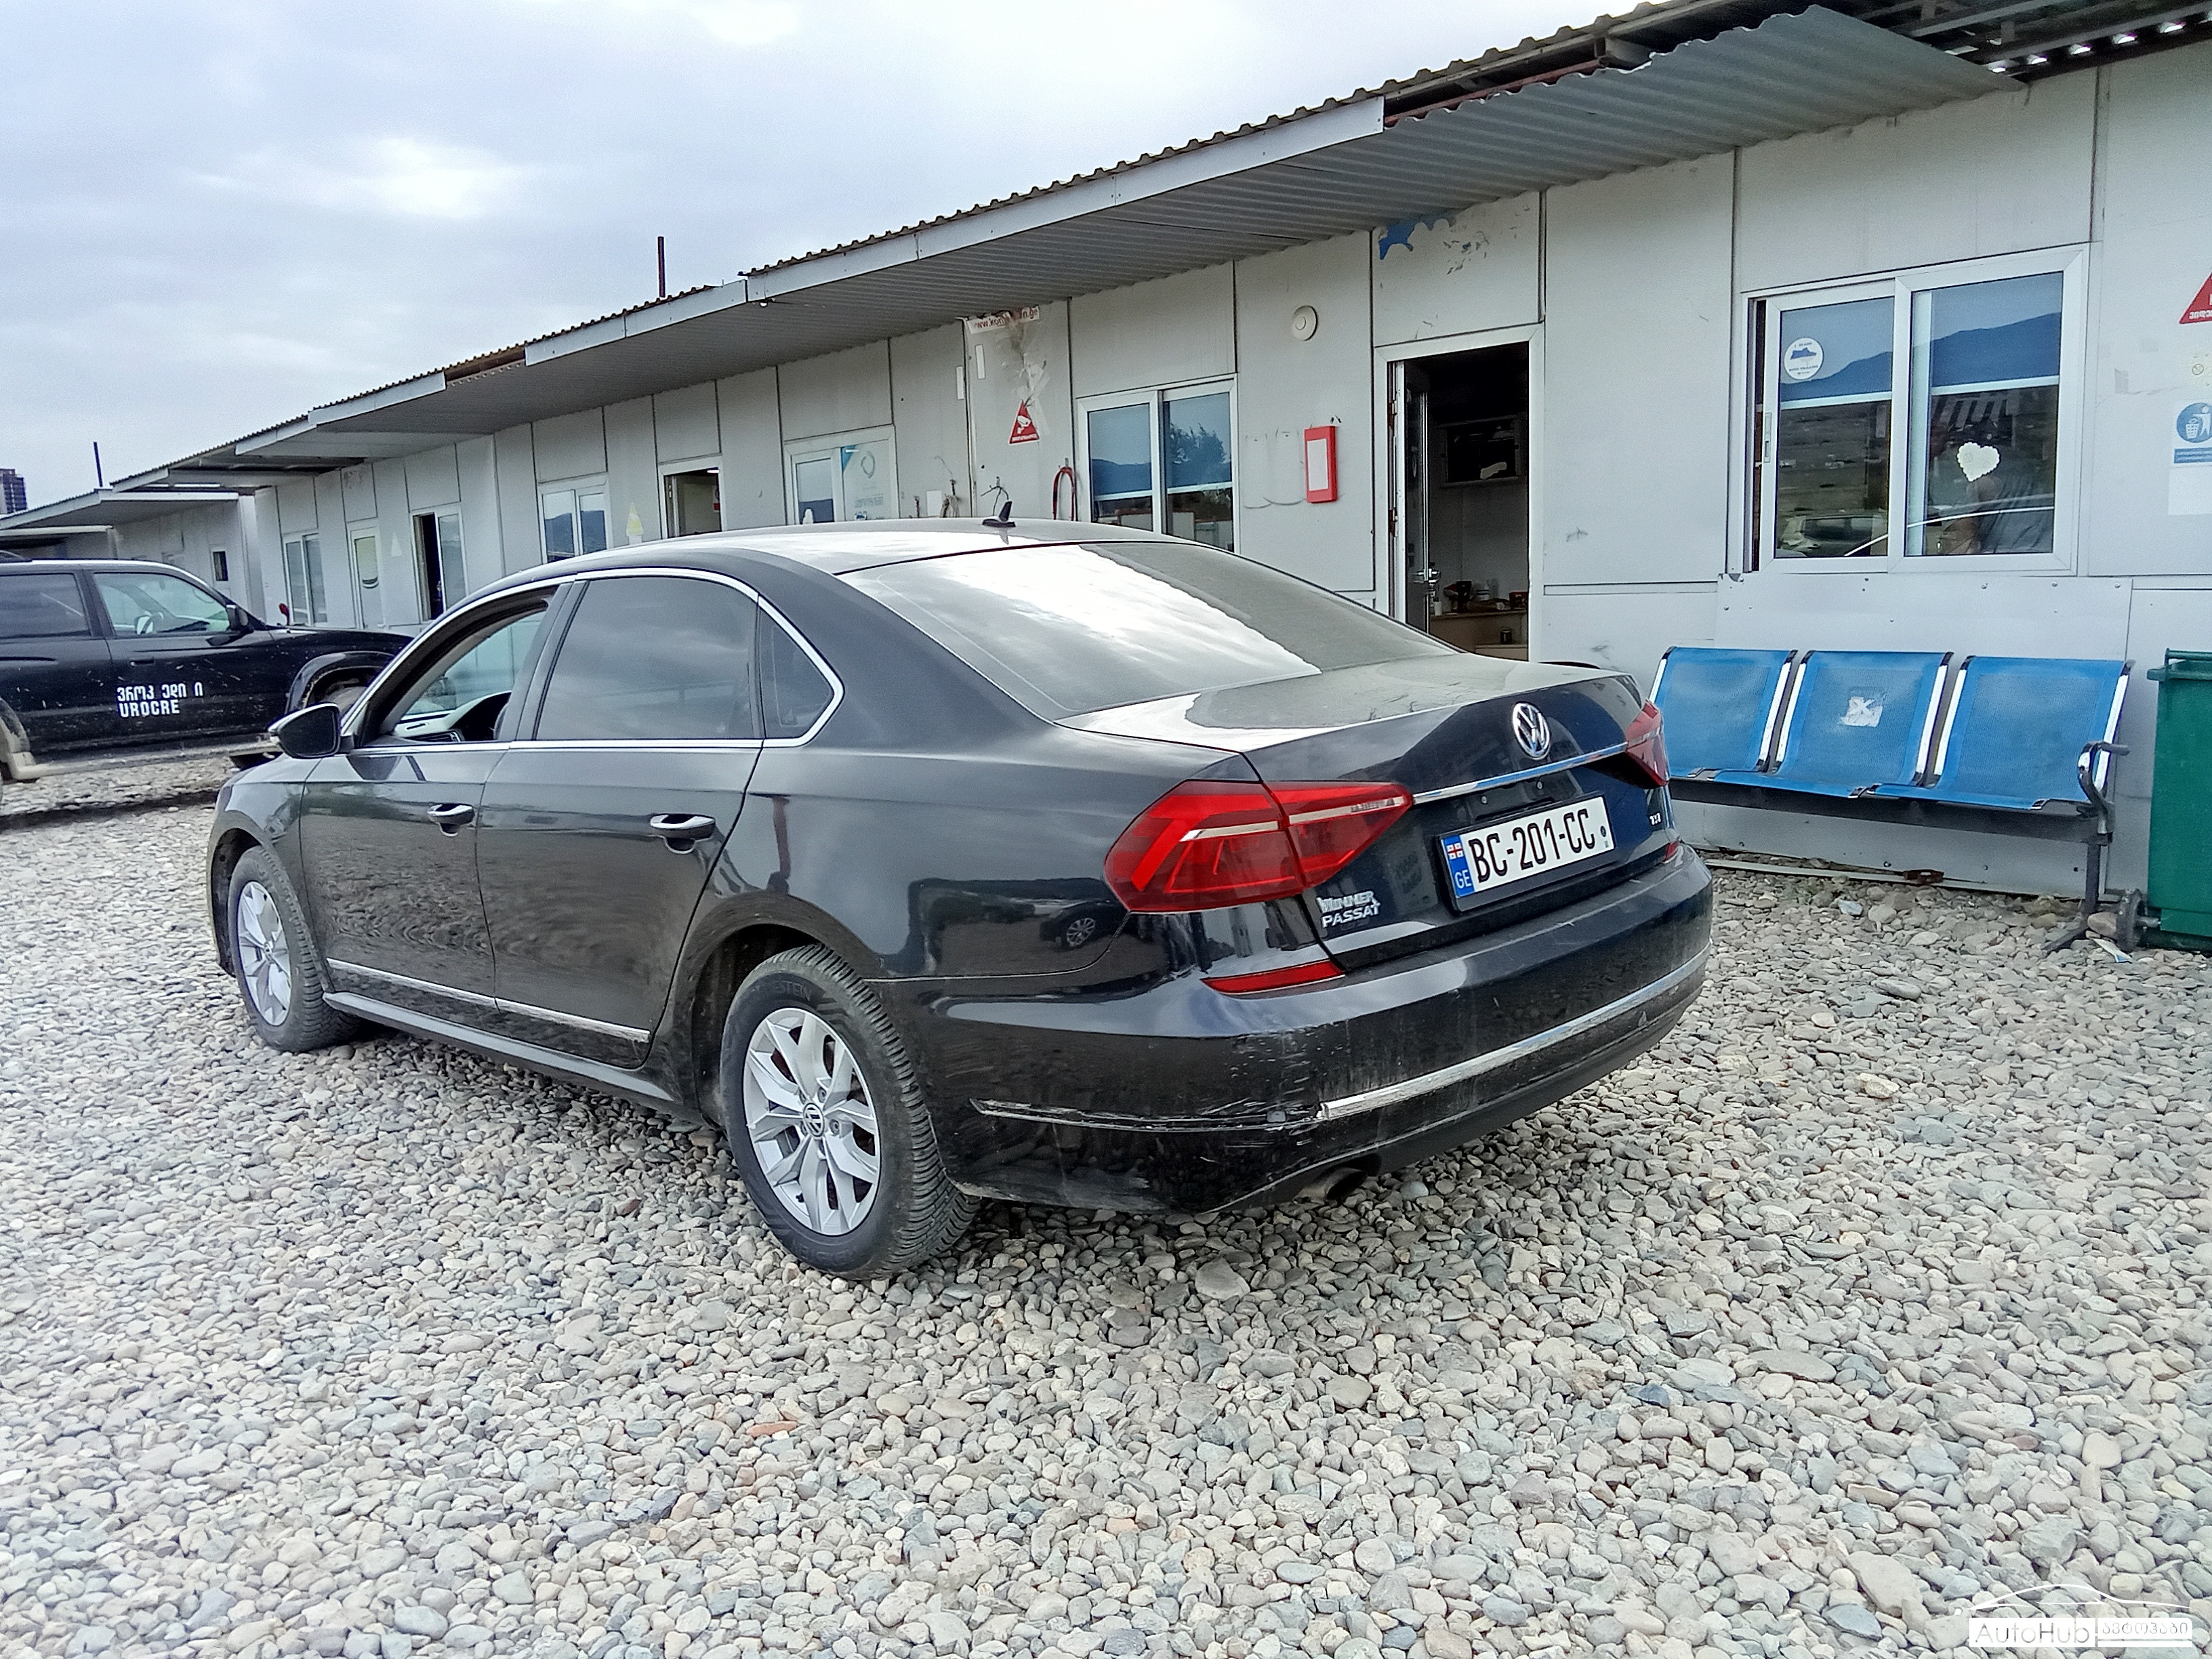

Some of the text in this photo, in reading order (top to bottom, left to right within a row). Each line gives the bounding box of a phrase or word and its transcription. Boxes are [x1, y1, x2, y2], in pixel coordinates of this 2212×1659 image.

[119, 699, 180, 718] UROCRE
[1468, 808, 1595, 883] BC-201-CC
[1454, 869, 1473, 889] GE
[1322, 903, 1381, 928] PASSAT
